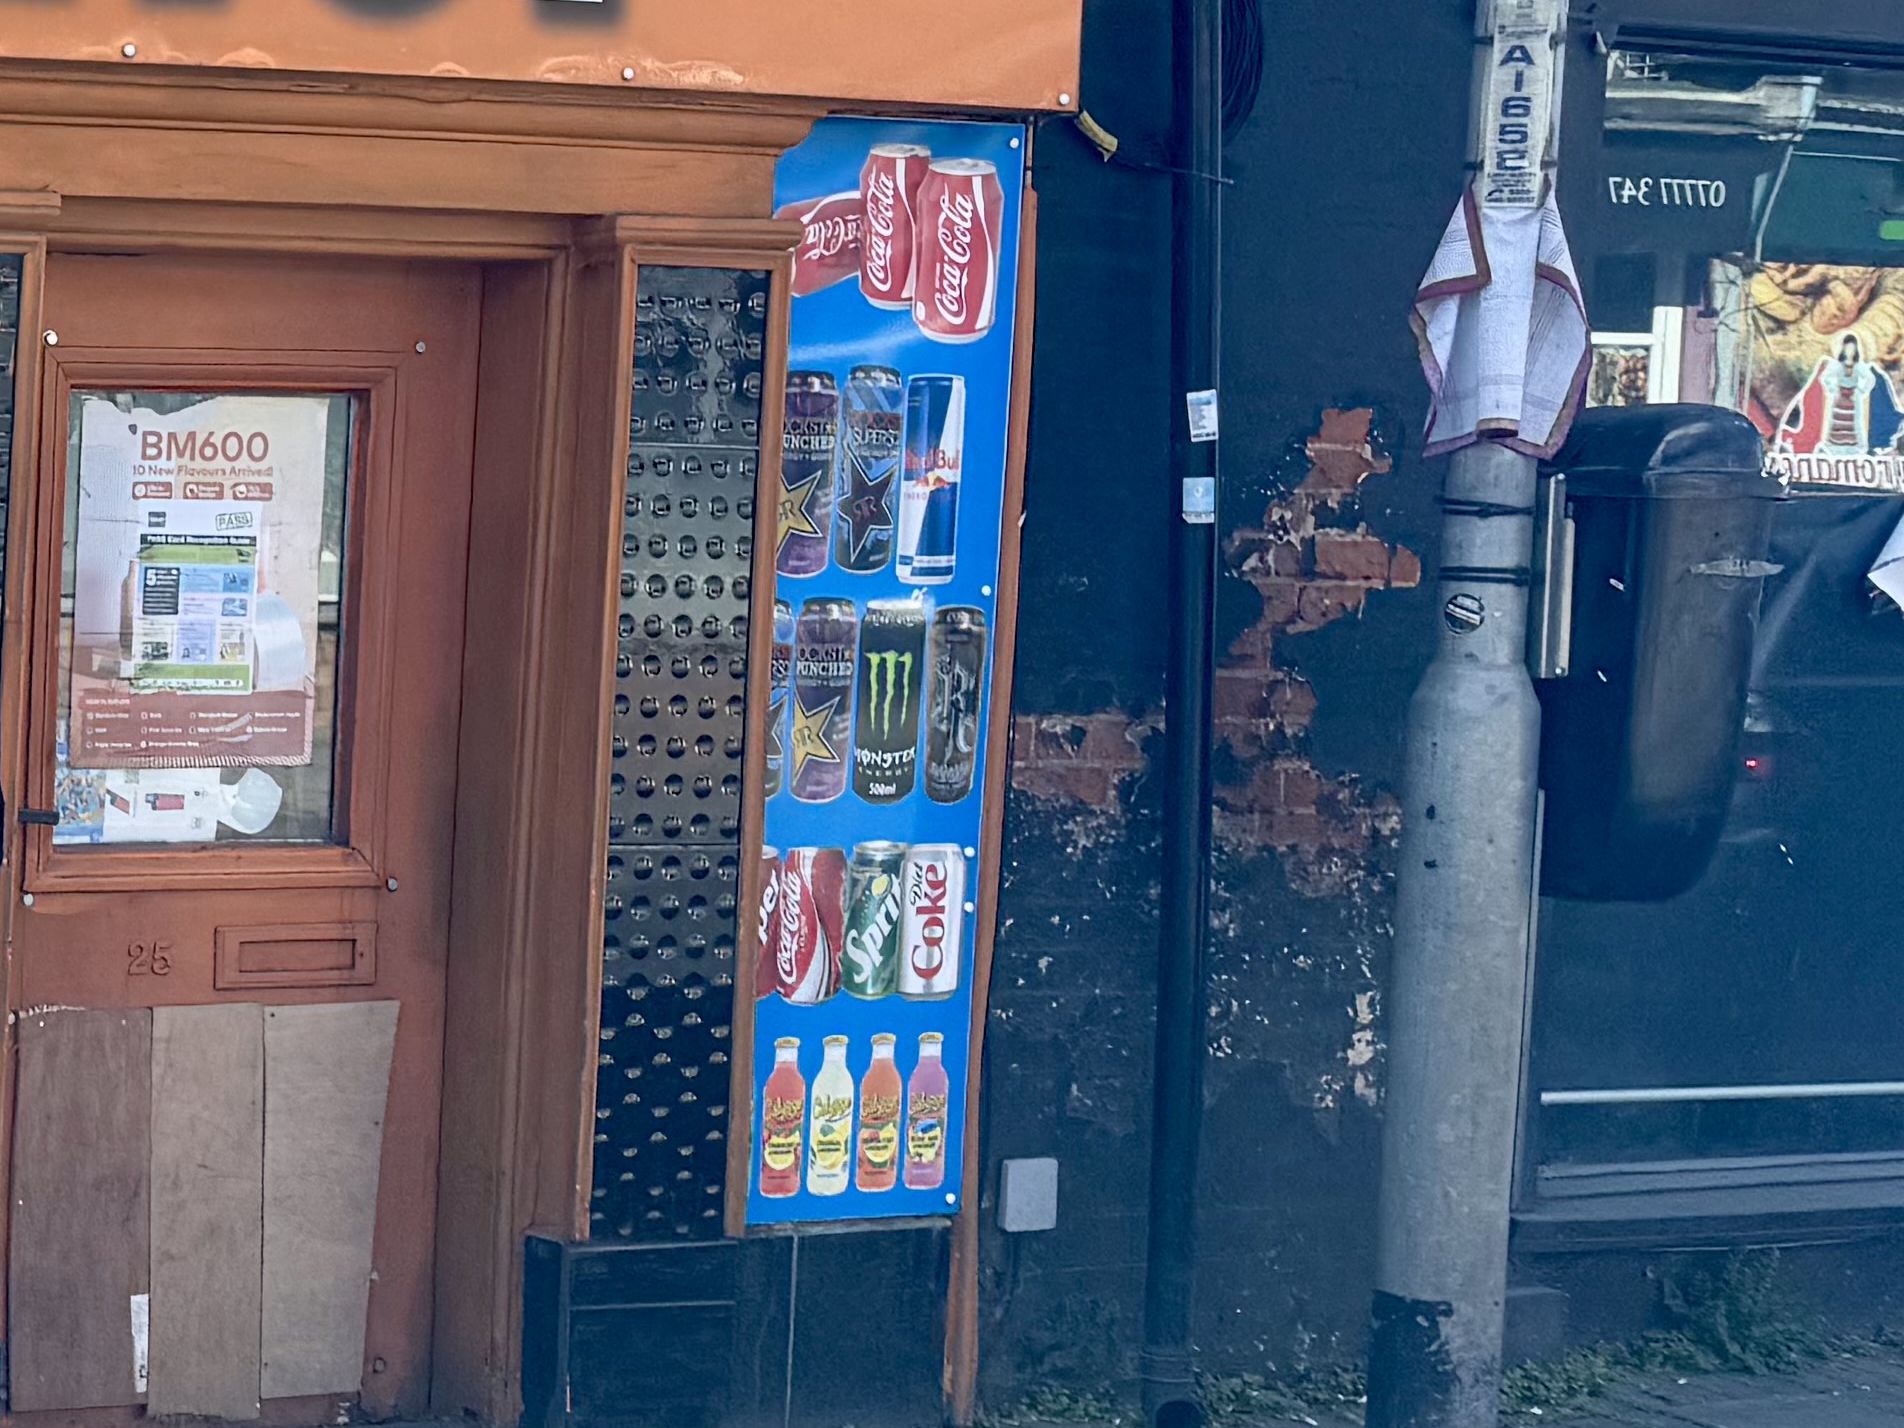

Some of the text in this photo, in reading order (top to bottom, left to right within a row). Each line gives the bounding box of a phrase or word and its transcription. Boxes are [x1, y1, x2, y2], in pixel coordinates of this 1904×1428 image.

[140, 430, 270, 462] BM600
[148, 465, 174, 476] New
[176, 465, 227, 477] Flavours
[218, 513, 252, 526] PASS
[146, 569, 157, 586] 5
[909, 862, 948, 981] Diet Coke
[127, 939, 173, 977] 25
